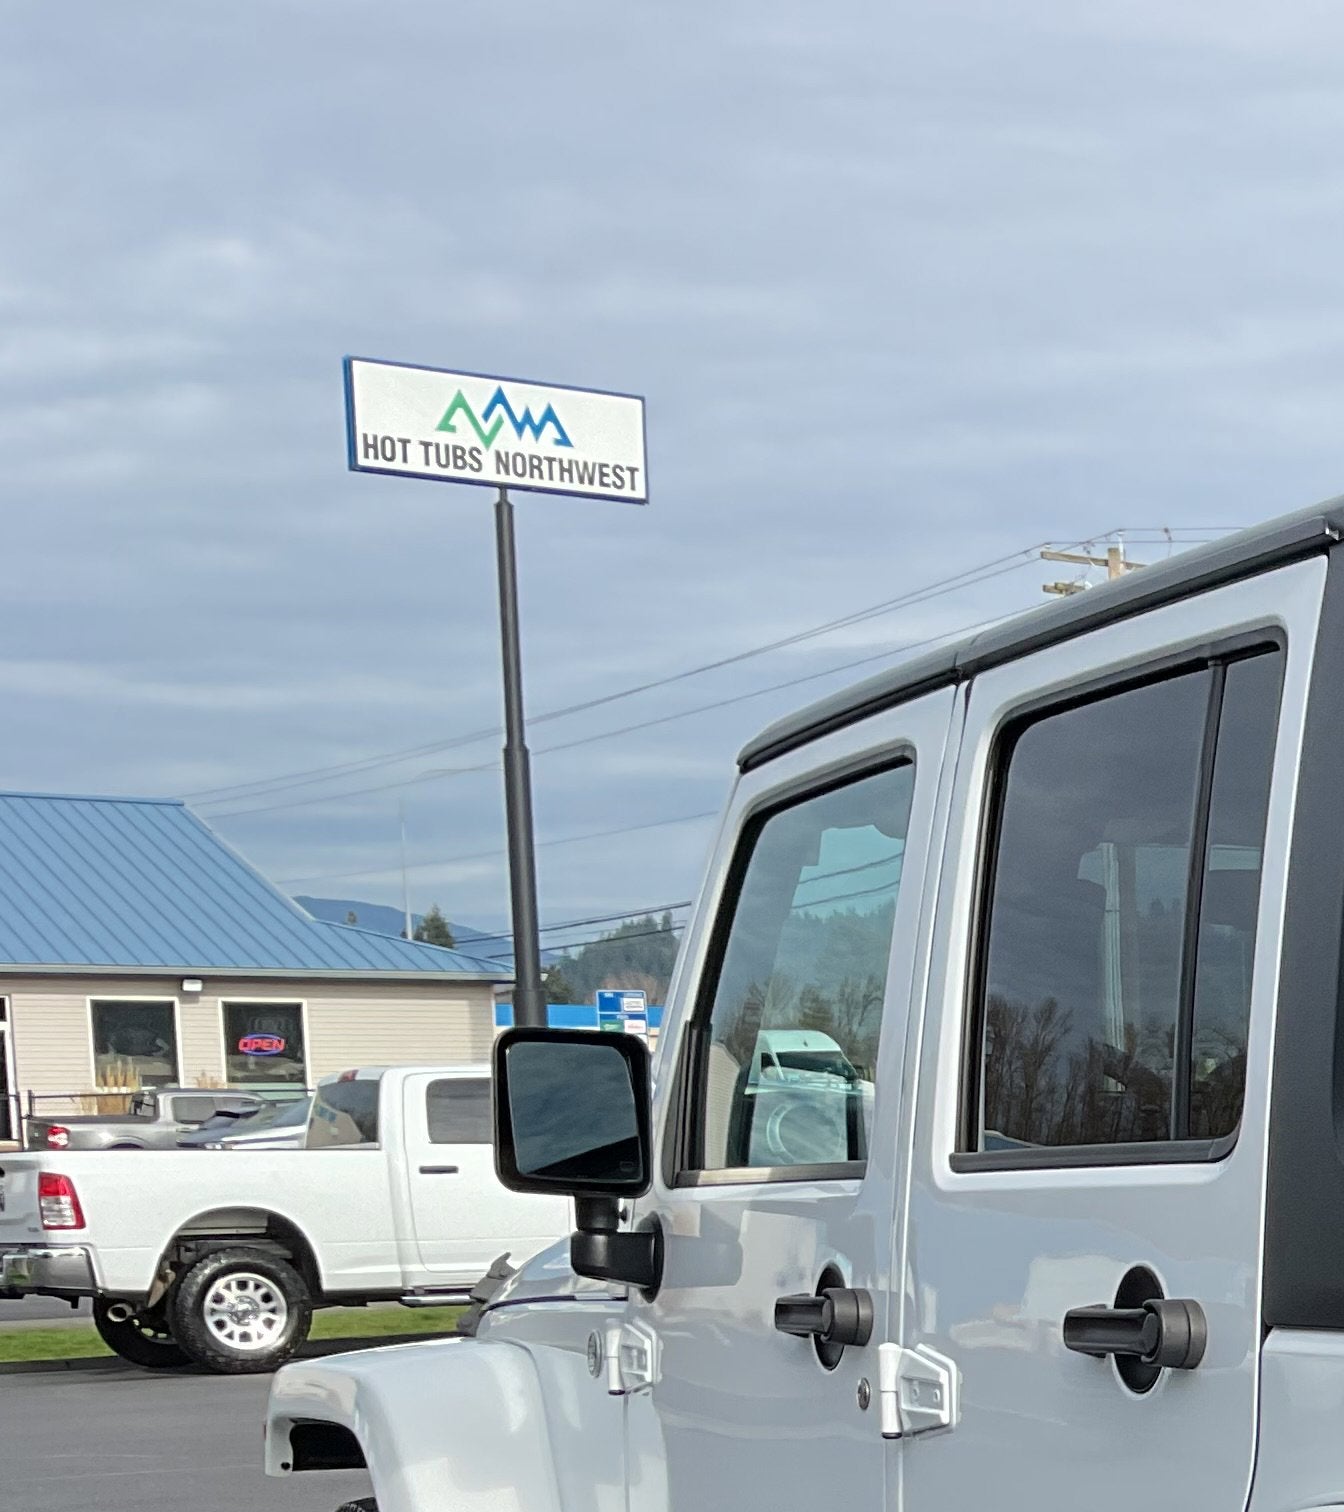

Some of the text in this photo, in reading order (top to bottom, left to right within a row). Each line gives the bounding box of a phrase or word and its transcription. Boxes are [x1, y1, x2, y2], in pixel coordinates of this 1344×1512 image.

[362, 433, 639, 491] HOT TUBS NORTHWEST
[239, 1038, 285, 1051] OPEN
